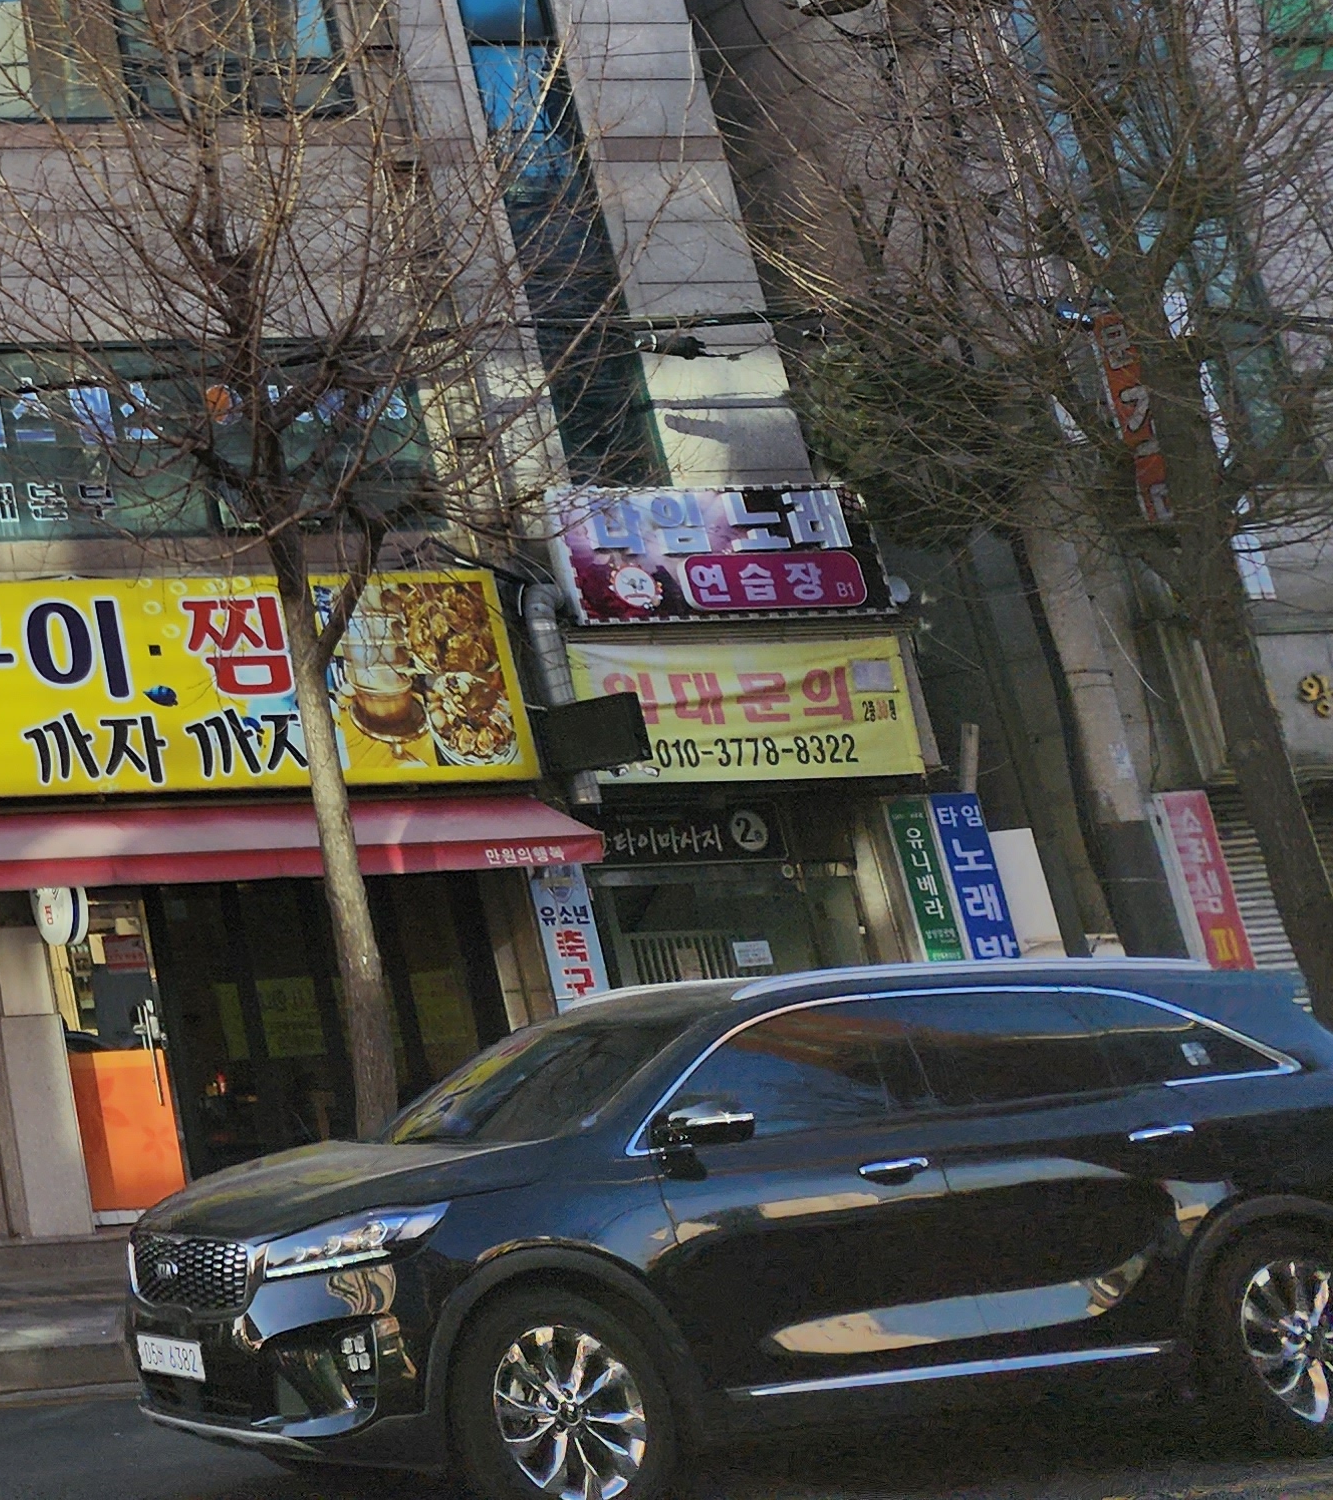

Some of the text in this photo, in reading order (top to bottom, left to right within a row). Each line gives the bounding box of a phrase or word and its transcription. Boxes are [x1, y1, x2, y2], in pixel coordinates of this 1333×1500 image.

[688, 561, 824, 604] 연습장
[655, 733, 860, 769] 010-3778-8322
[905, 827, 945, 920] 유니베라
[540, 904, 591, 927] 유소년
